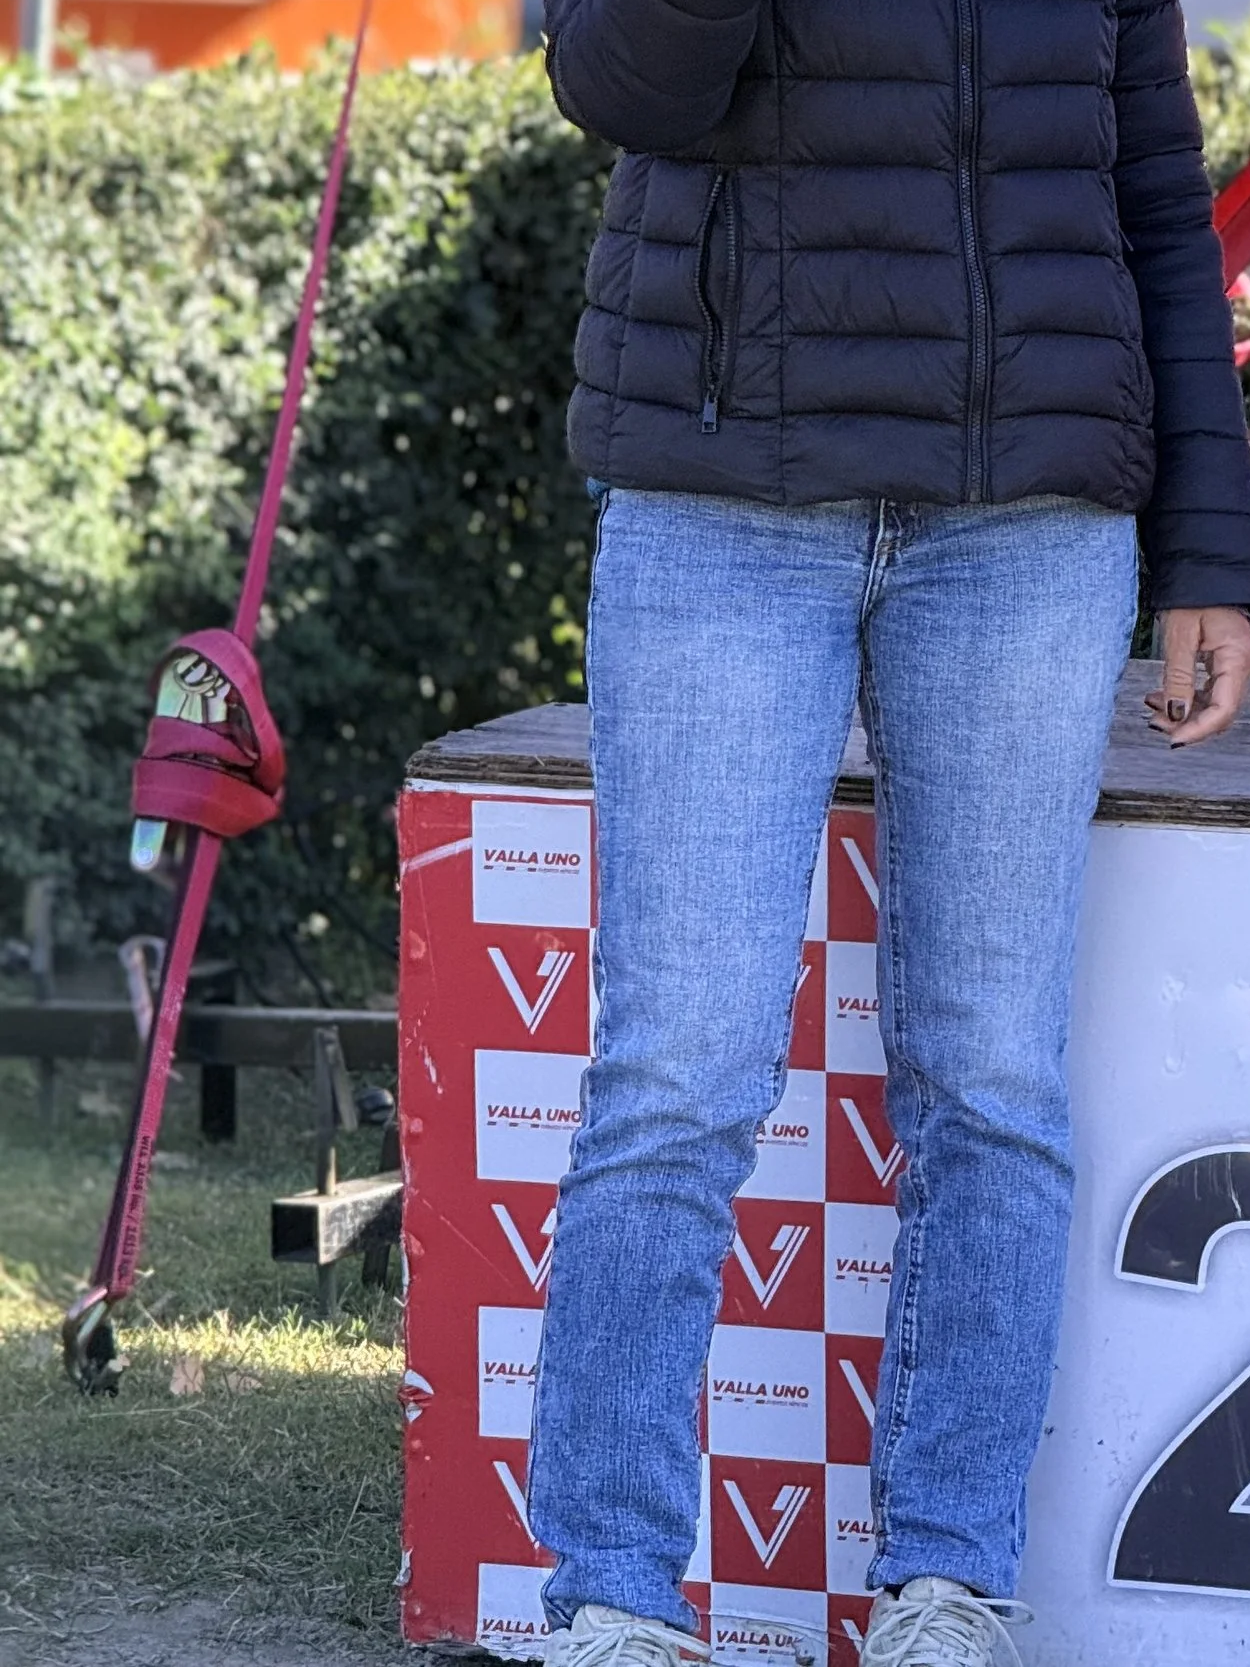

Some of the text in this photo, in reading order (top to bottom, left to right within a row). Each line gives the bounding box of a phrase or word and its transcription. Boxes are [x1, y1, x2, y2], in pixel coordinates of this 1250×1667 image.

[485, 849, 580, 866] VALLA UNO
[838, 997, 880, 1012] VALL
[488, 1105, 581, 1123] VALLA UNO
[772, 1124, 809, 1138] UNO
[713, 1380, 809, 1399] VALLA UNO
[838, 1520, 875, 1535] VAL
[482, 1618, 534, 1635] VALLA
[716, 1630, 796, 1647] VALLA UN
